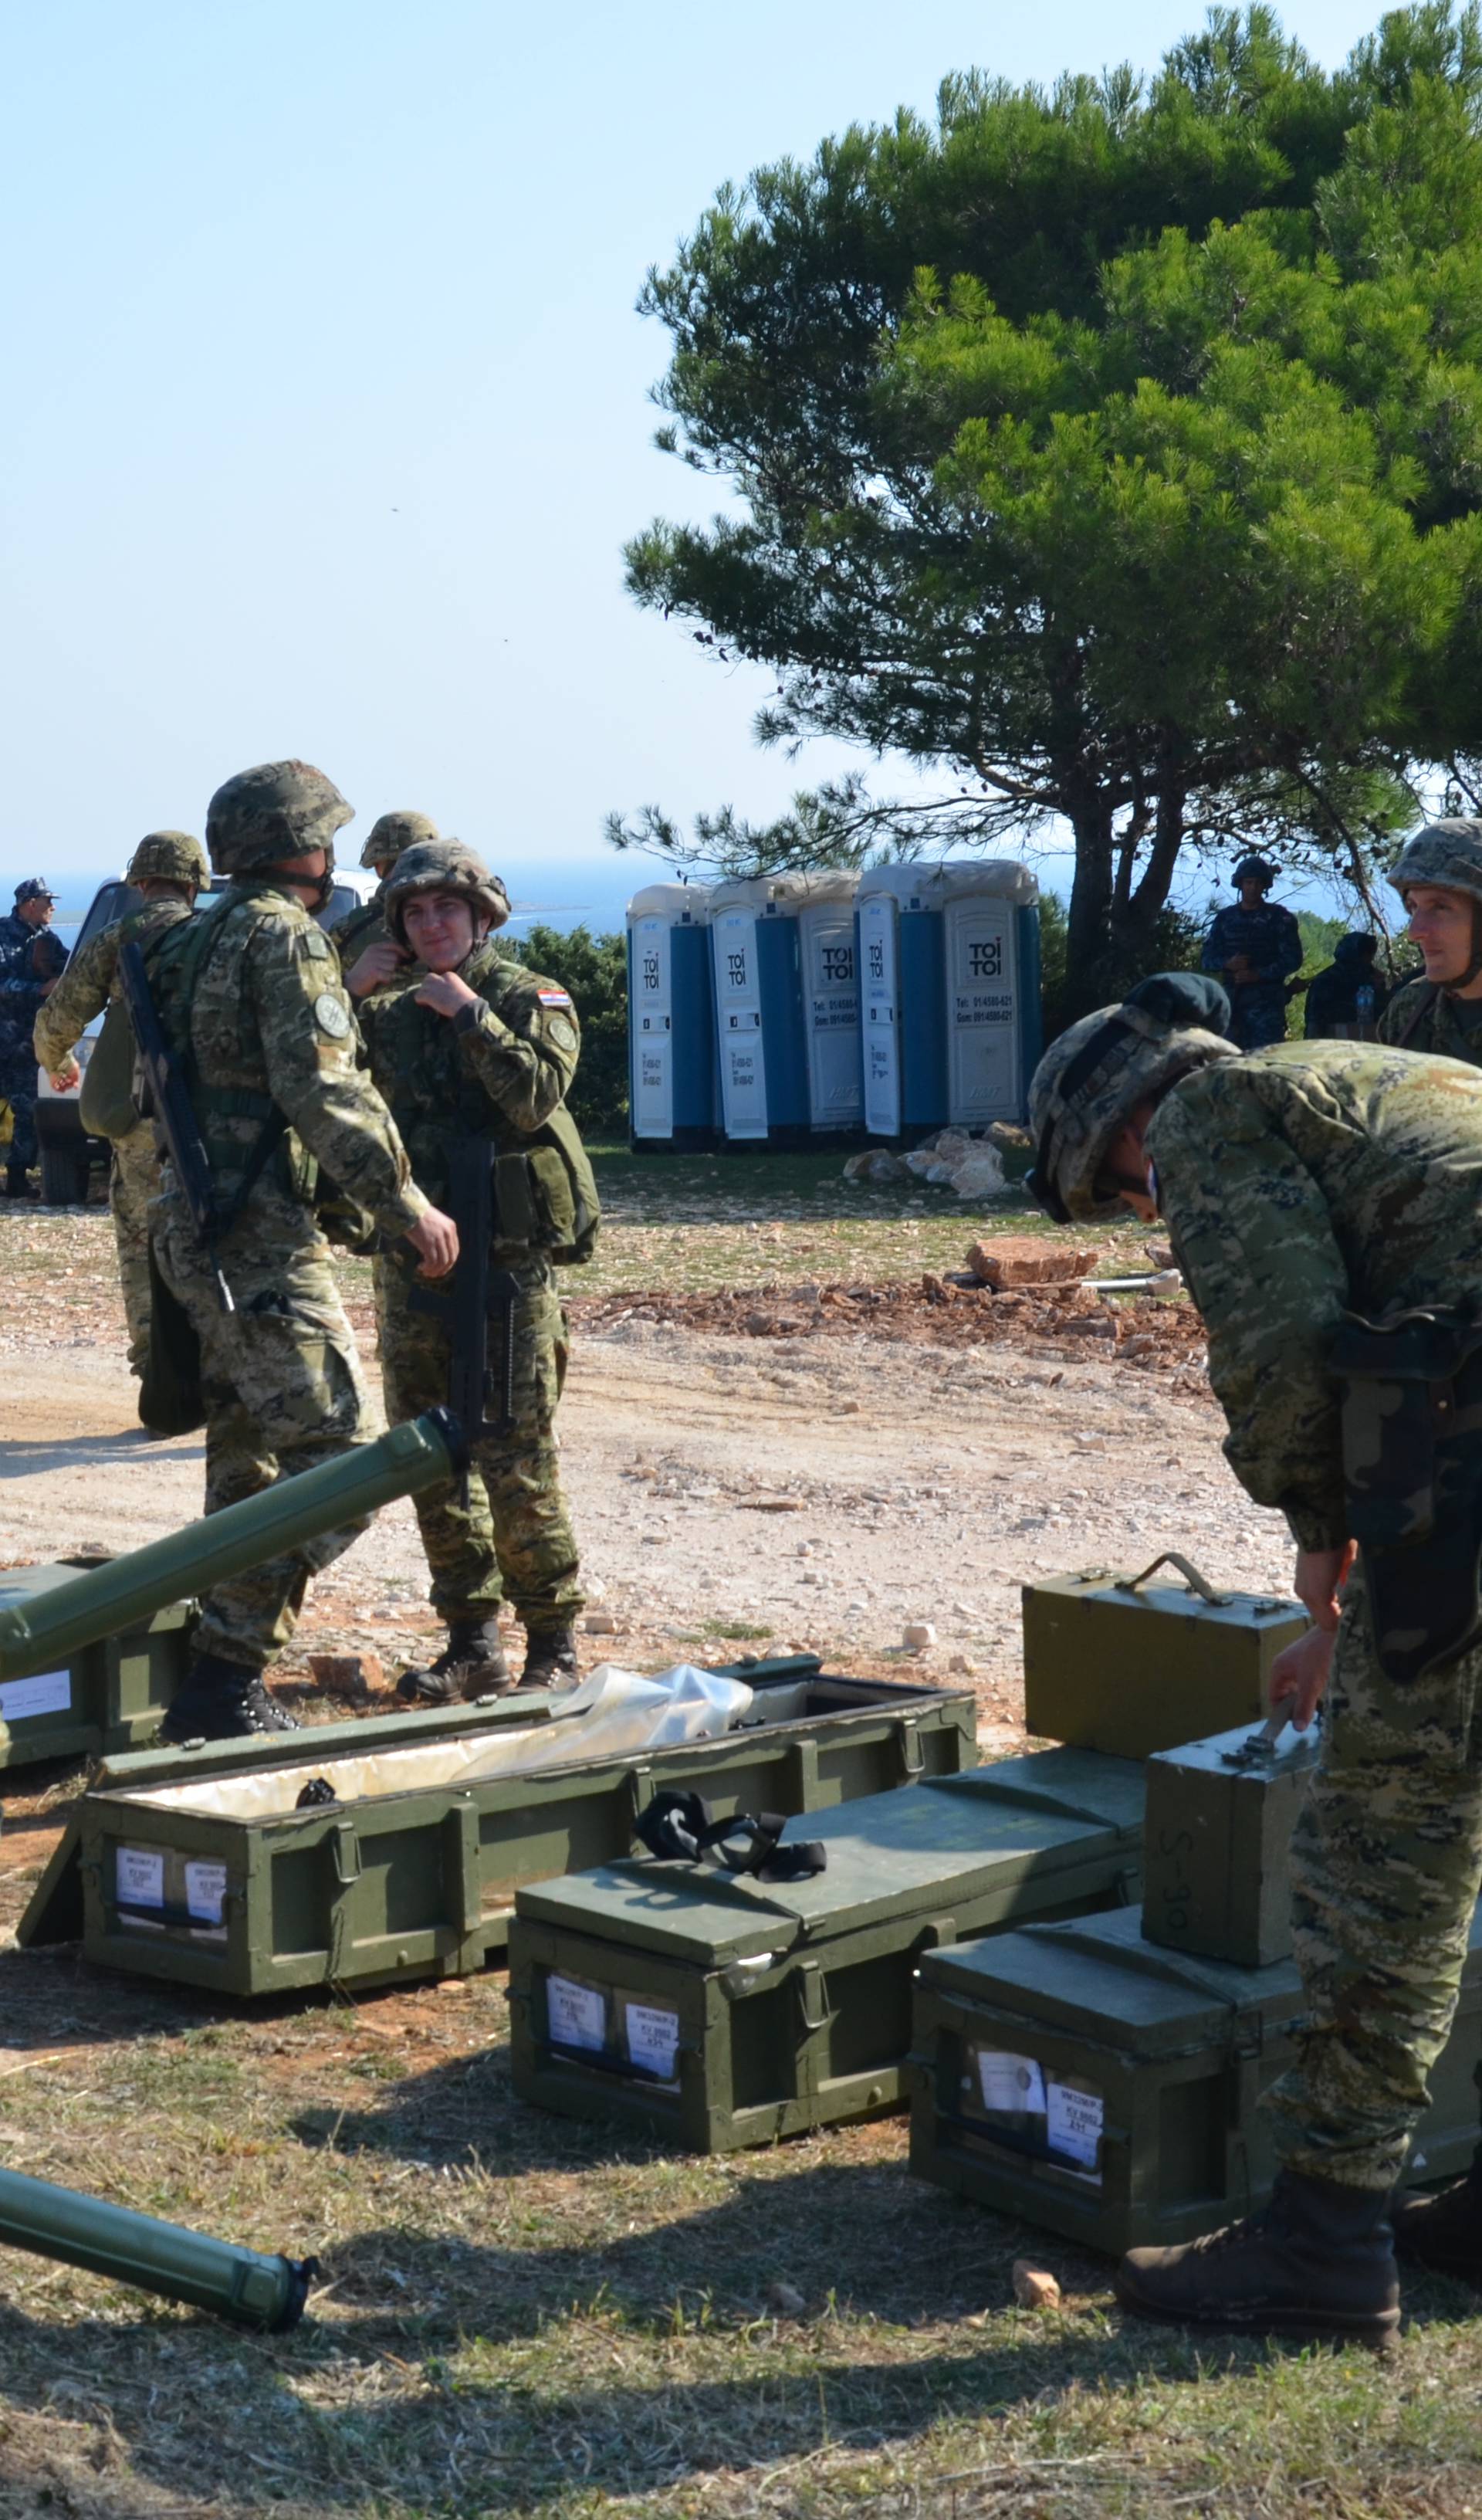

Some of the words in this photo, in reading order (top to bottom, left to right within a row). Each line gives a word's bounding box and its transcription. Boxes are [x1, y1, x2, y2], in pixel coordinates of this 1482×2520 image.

[822, 947, 852, 964] TOI
[823, 964, 853, 981] TOI
[870, 963, 883, 977] TOI
[969, 960, 1001, 976] TOI
[644, 974, 659, 989] TOI
[729, 971, 746, 986] TOI
